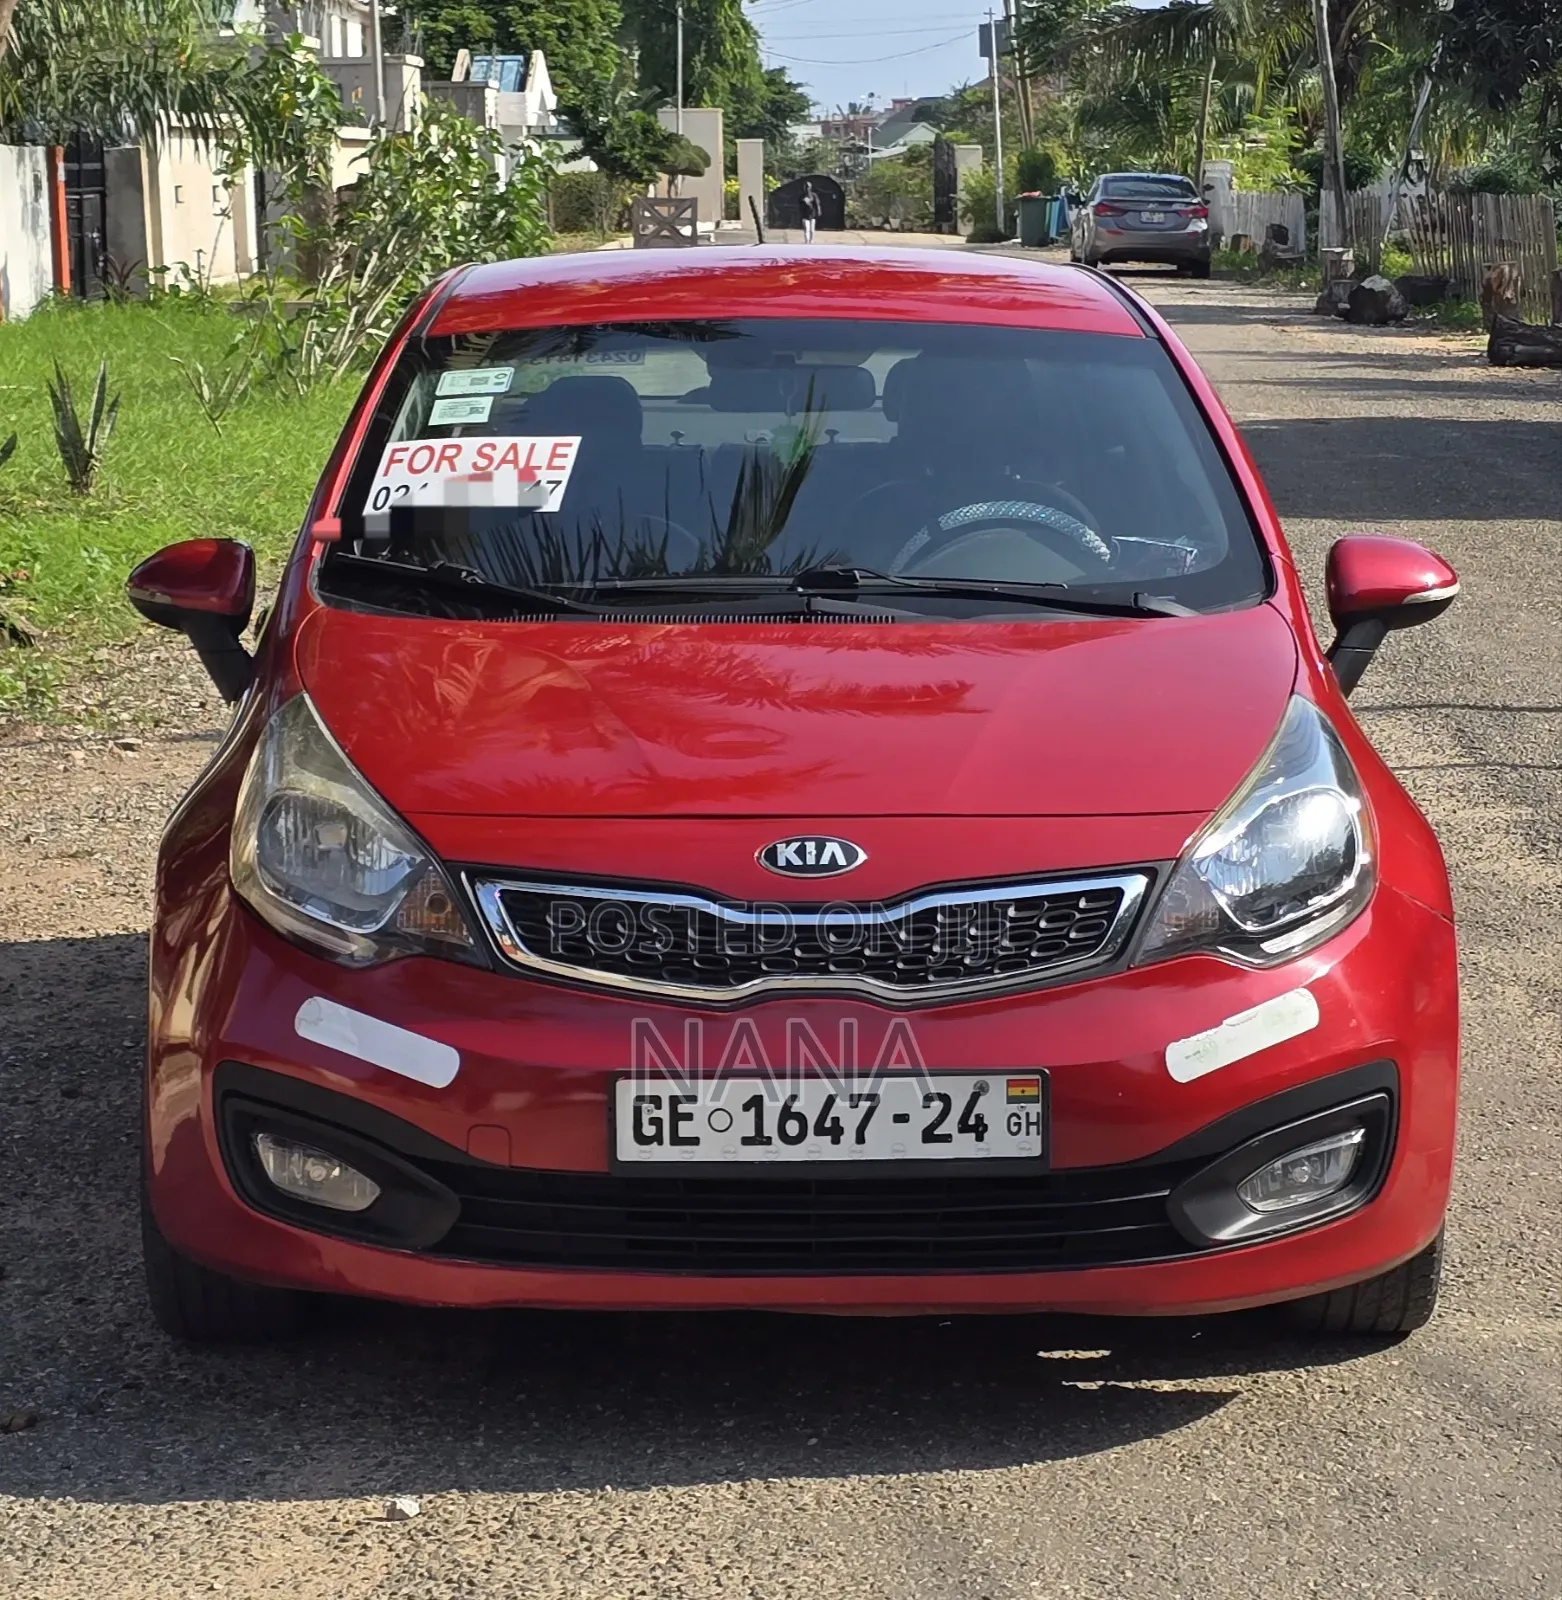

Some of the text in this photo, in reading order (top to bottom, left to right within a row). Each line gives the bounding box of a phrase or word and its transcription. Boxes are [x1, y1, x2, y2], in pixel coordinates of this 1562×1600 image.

[383, 443, 573, 477] FOR SALE
[776, 841, 847, 867] KIA
[632, 1091, 989, 1146] GE 1647-24
[1006, 1110, 1042, 1137] GH
